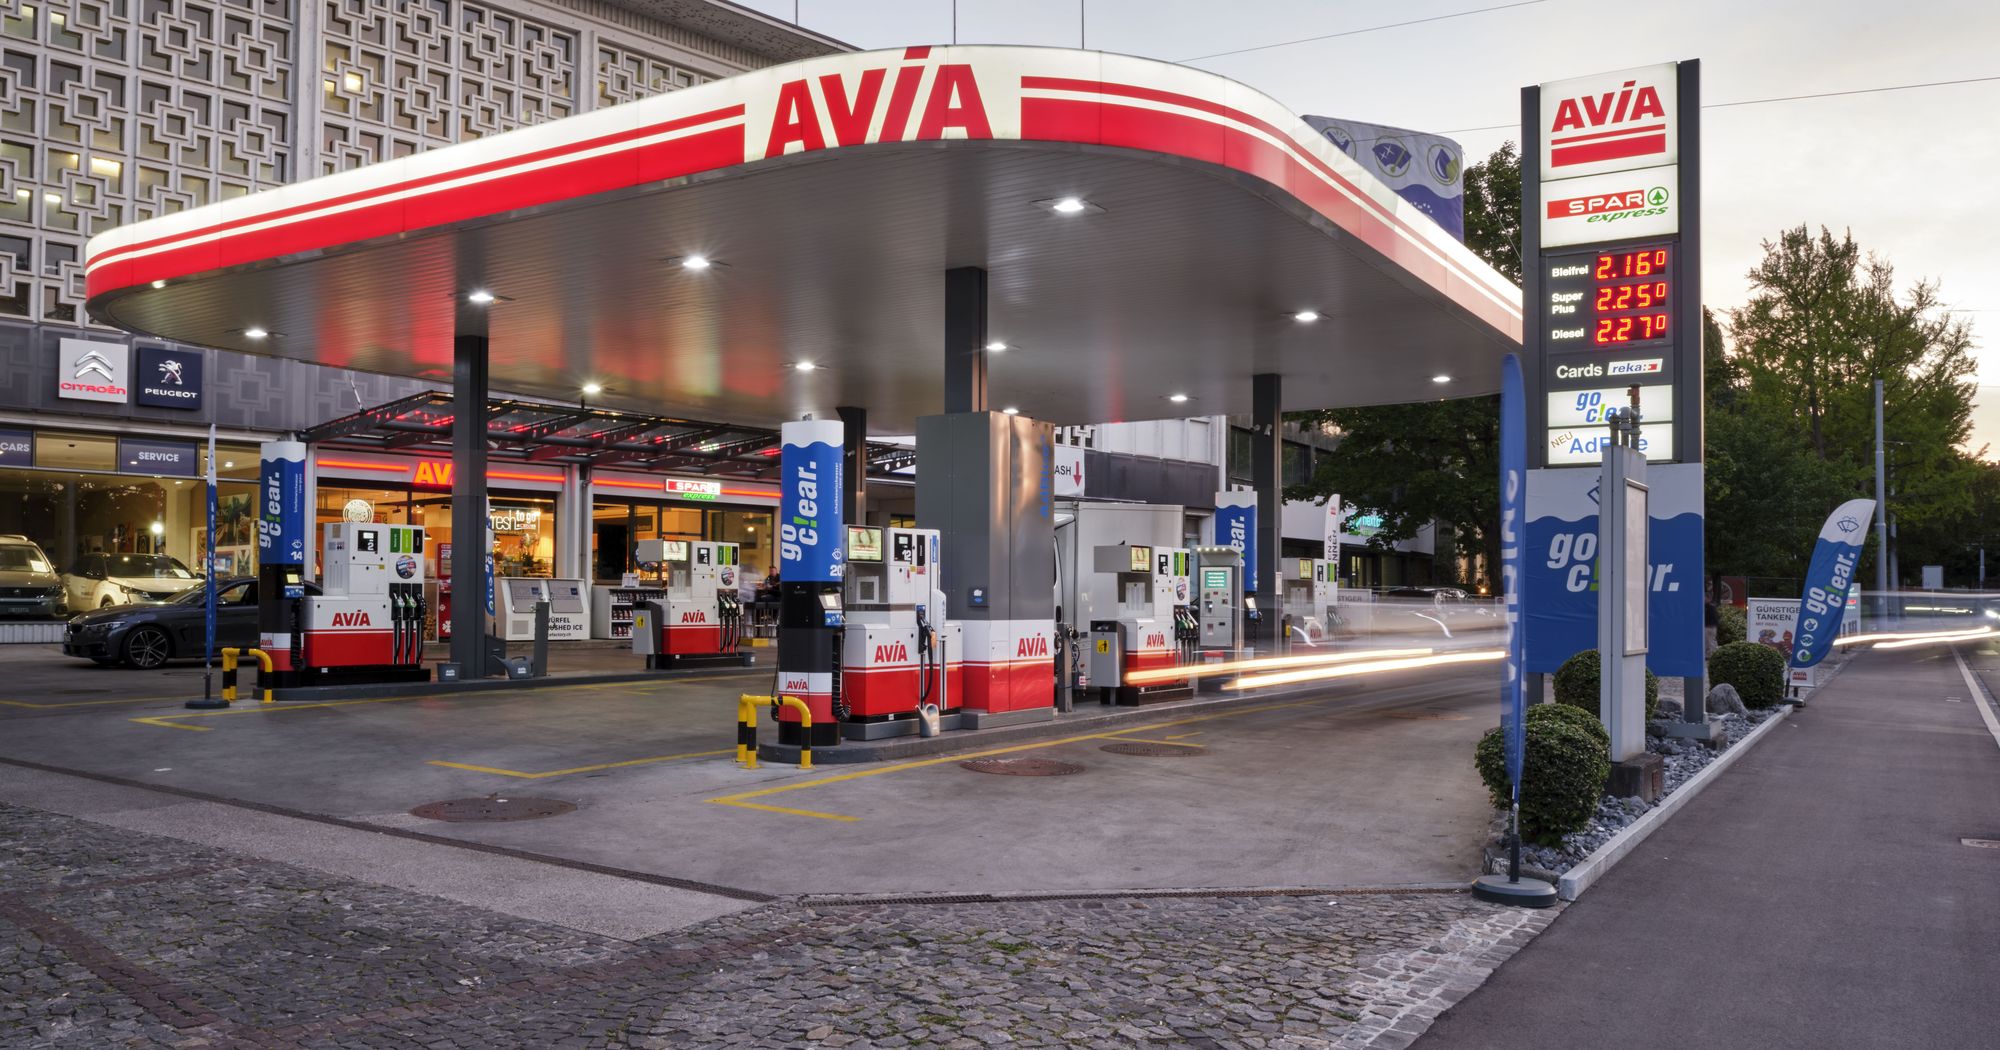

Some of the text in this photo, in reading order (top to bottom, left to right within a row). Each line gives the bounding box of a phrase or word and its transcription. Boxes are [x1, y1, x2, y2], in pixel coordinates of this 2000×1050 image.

[764, 45, 994, 160] AVIA
[1551, 80, 1666, 132] AVIA
[1568, 192, 1644, 214] SPAR
[1586, 206, 1669, 224] express
[1551, 264, 1589, 278] Bleifrei
[1551, 291, 1584, 306] Super
[1551, 304, 1576, 315] Plus
[1551, 328, 1585, 340] Diesel
[1556, 363, 1604, 379] Cards
[144, 387, 198, 399] PEUGEOT
[1575, 391, 1602, 412] go
[0, 442, 31, 453] CARS
[1550, 431, 1574, 448] NEU
[138, 451, 180, 463] SERVICE
[413, 460, 452, 486] AV
[1054, 465, 1072, 476] ASH
[490, 509, 516, 530] resh
[258, 520, 272, 549] go
[781, 524, 802, 562] go
[1547, 532, 1598, 569] go
[291, 551, 303, 561] 14
[902, 549, 912, 561] 12
[829, 565, 842, 577] 20
[1756, 604, 1801, 614] GÜNSTIGE
[1806, 587, 1828, 615] go
[332, 609, 371, 627] AVIA
[548, 616, 571, 624] ÜRFEL
[681, 609, 706, 624] AVIA
[1017, 632, 1048, 658] AVIA
[1146, 631, 1165, 648] AVIA
[874, 640, 908, 664] AVIA
[786, 677, 808, 691] AVIA
